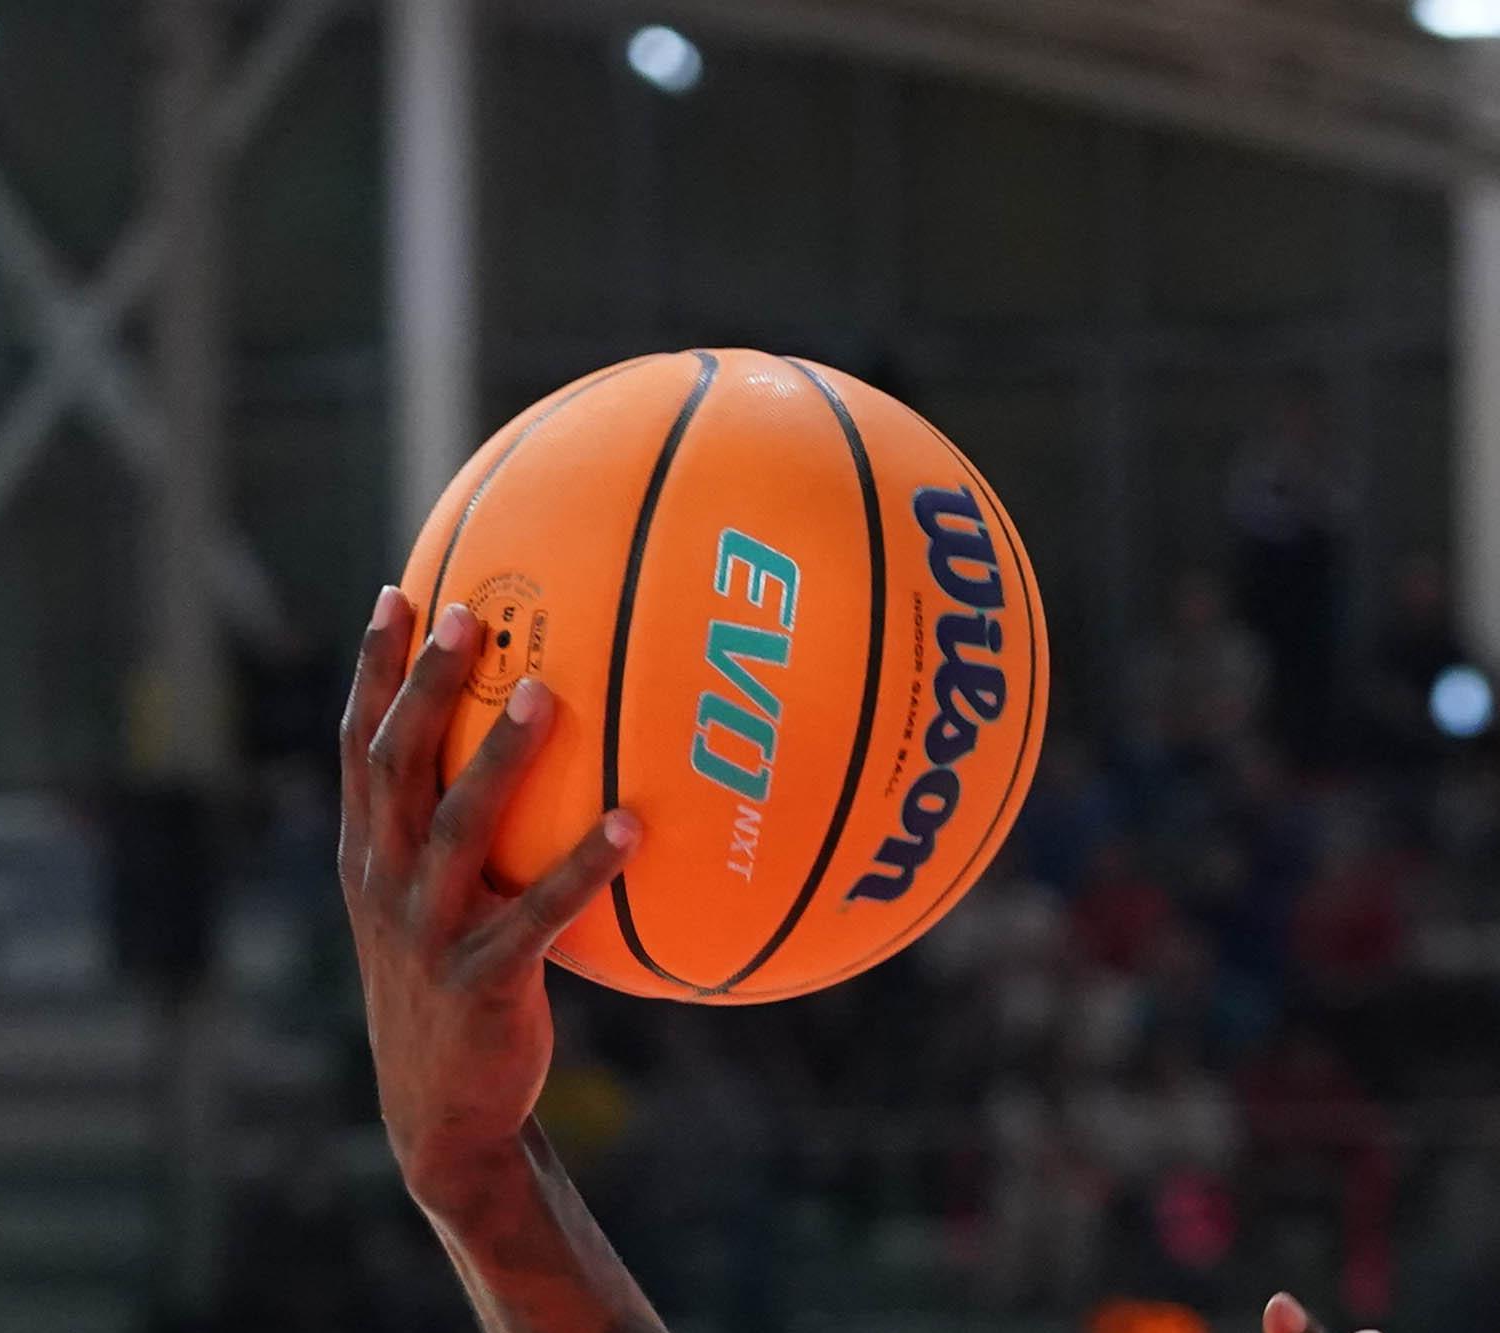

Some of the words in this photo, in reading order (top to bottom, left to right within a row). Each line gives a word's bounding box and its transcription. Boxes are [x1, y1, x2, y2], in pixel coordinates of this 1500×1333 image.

[689, 526, 801, 804] EVO
[844, 484, 1008, 908] Wilson
[726, 803, 764, 884] NXT
